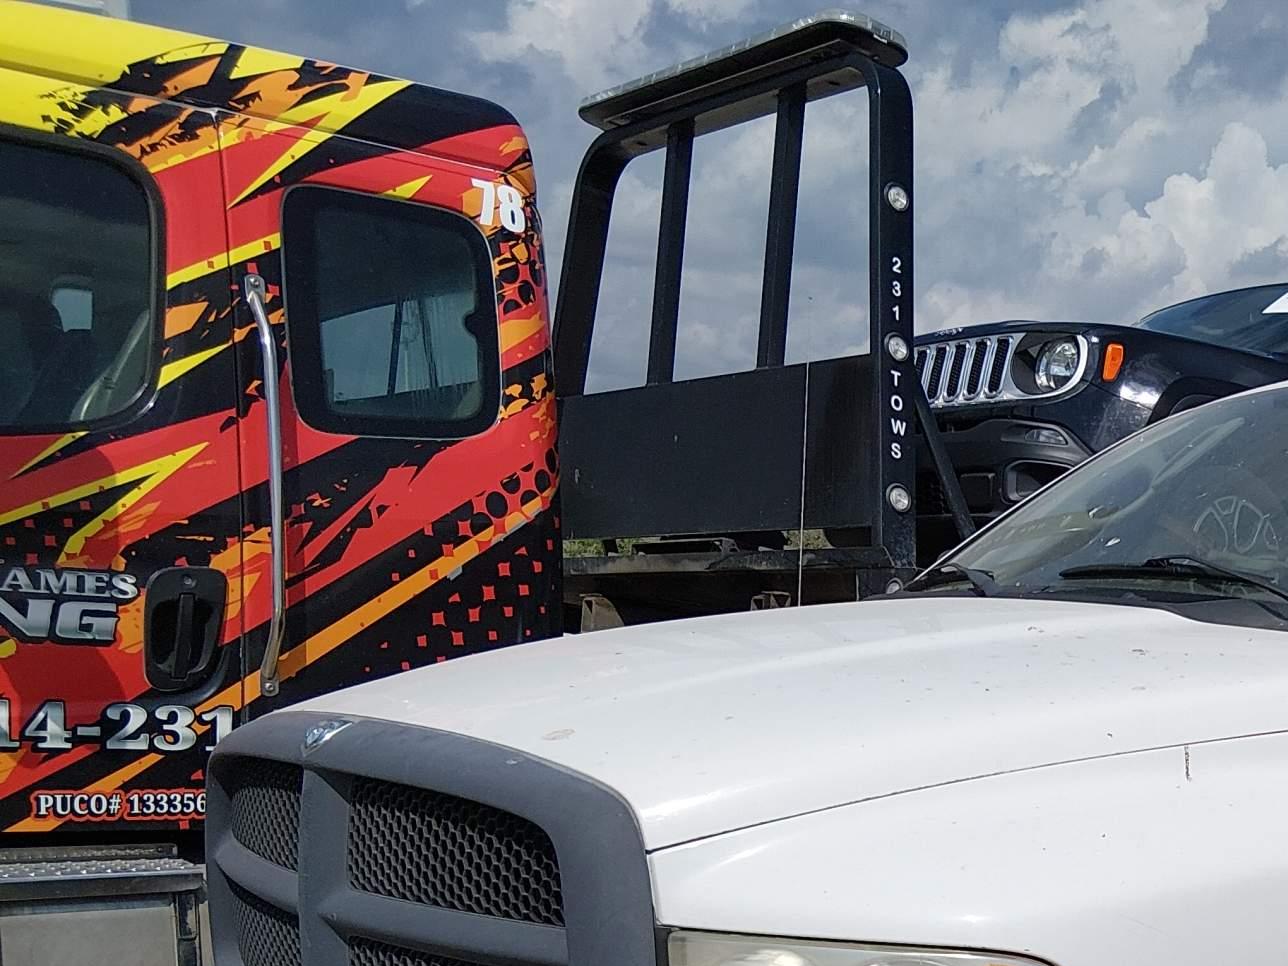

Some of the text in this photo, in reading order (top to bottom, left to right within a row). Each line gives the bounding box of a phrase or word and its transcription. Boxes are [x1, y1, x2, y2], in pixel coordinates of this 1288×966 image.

[470, 178, 526, 233] 78
[890, 256, 907, 459] 231 TOWS
[38, 793, 121, 815] PUCO#
